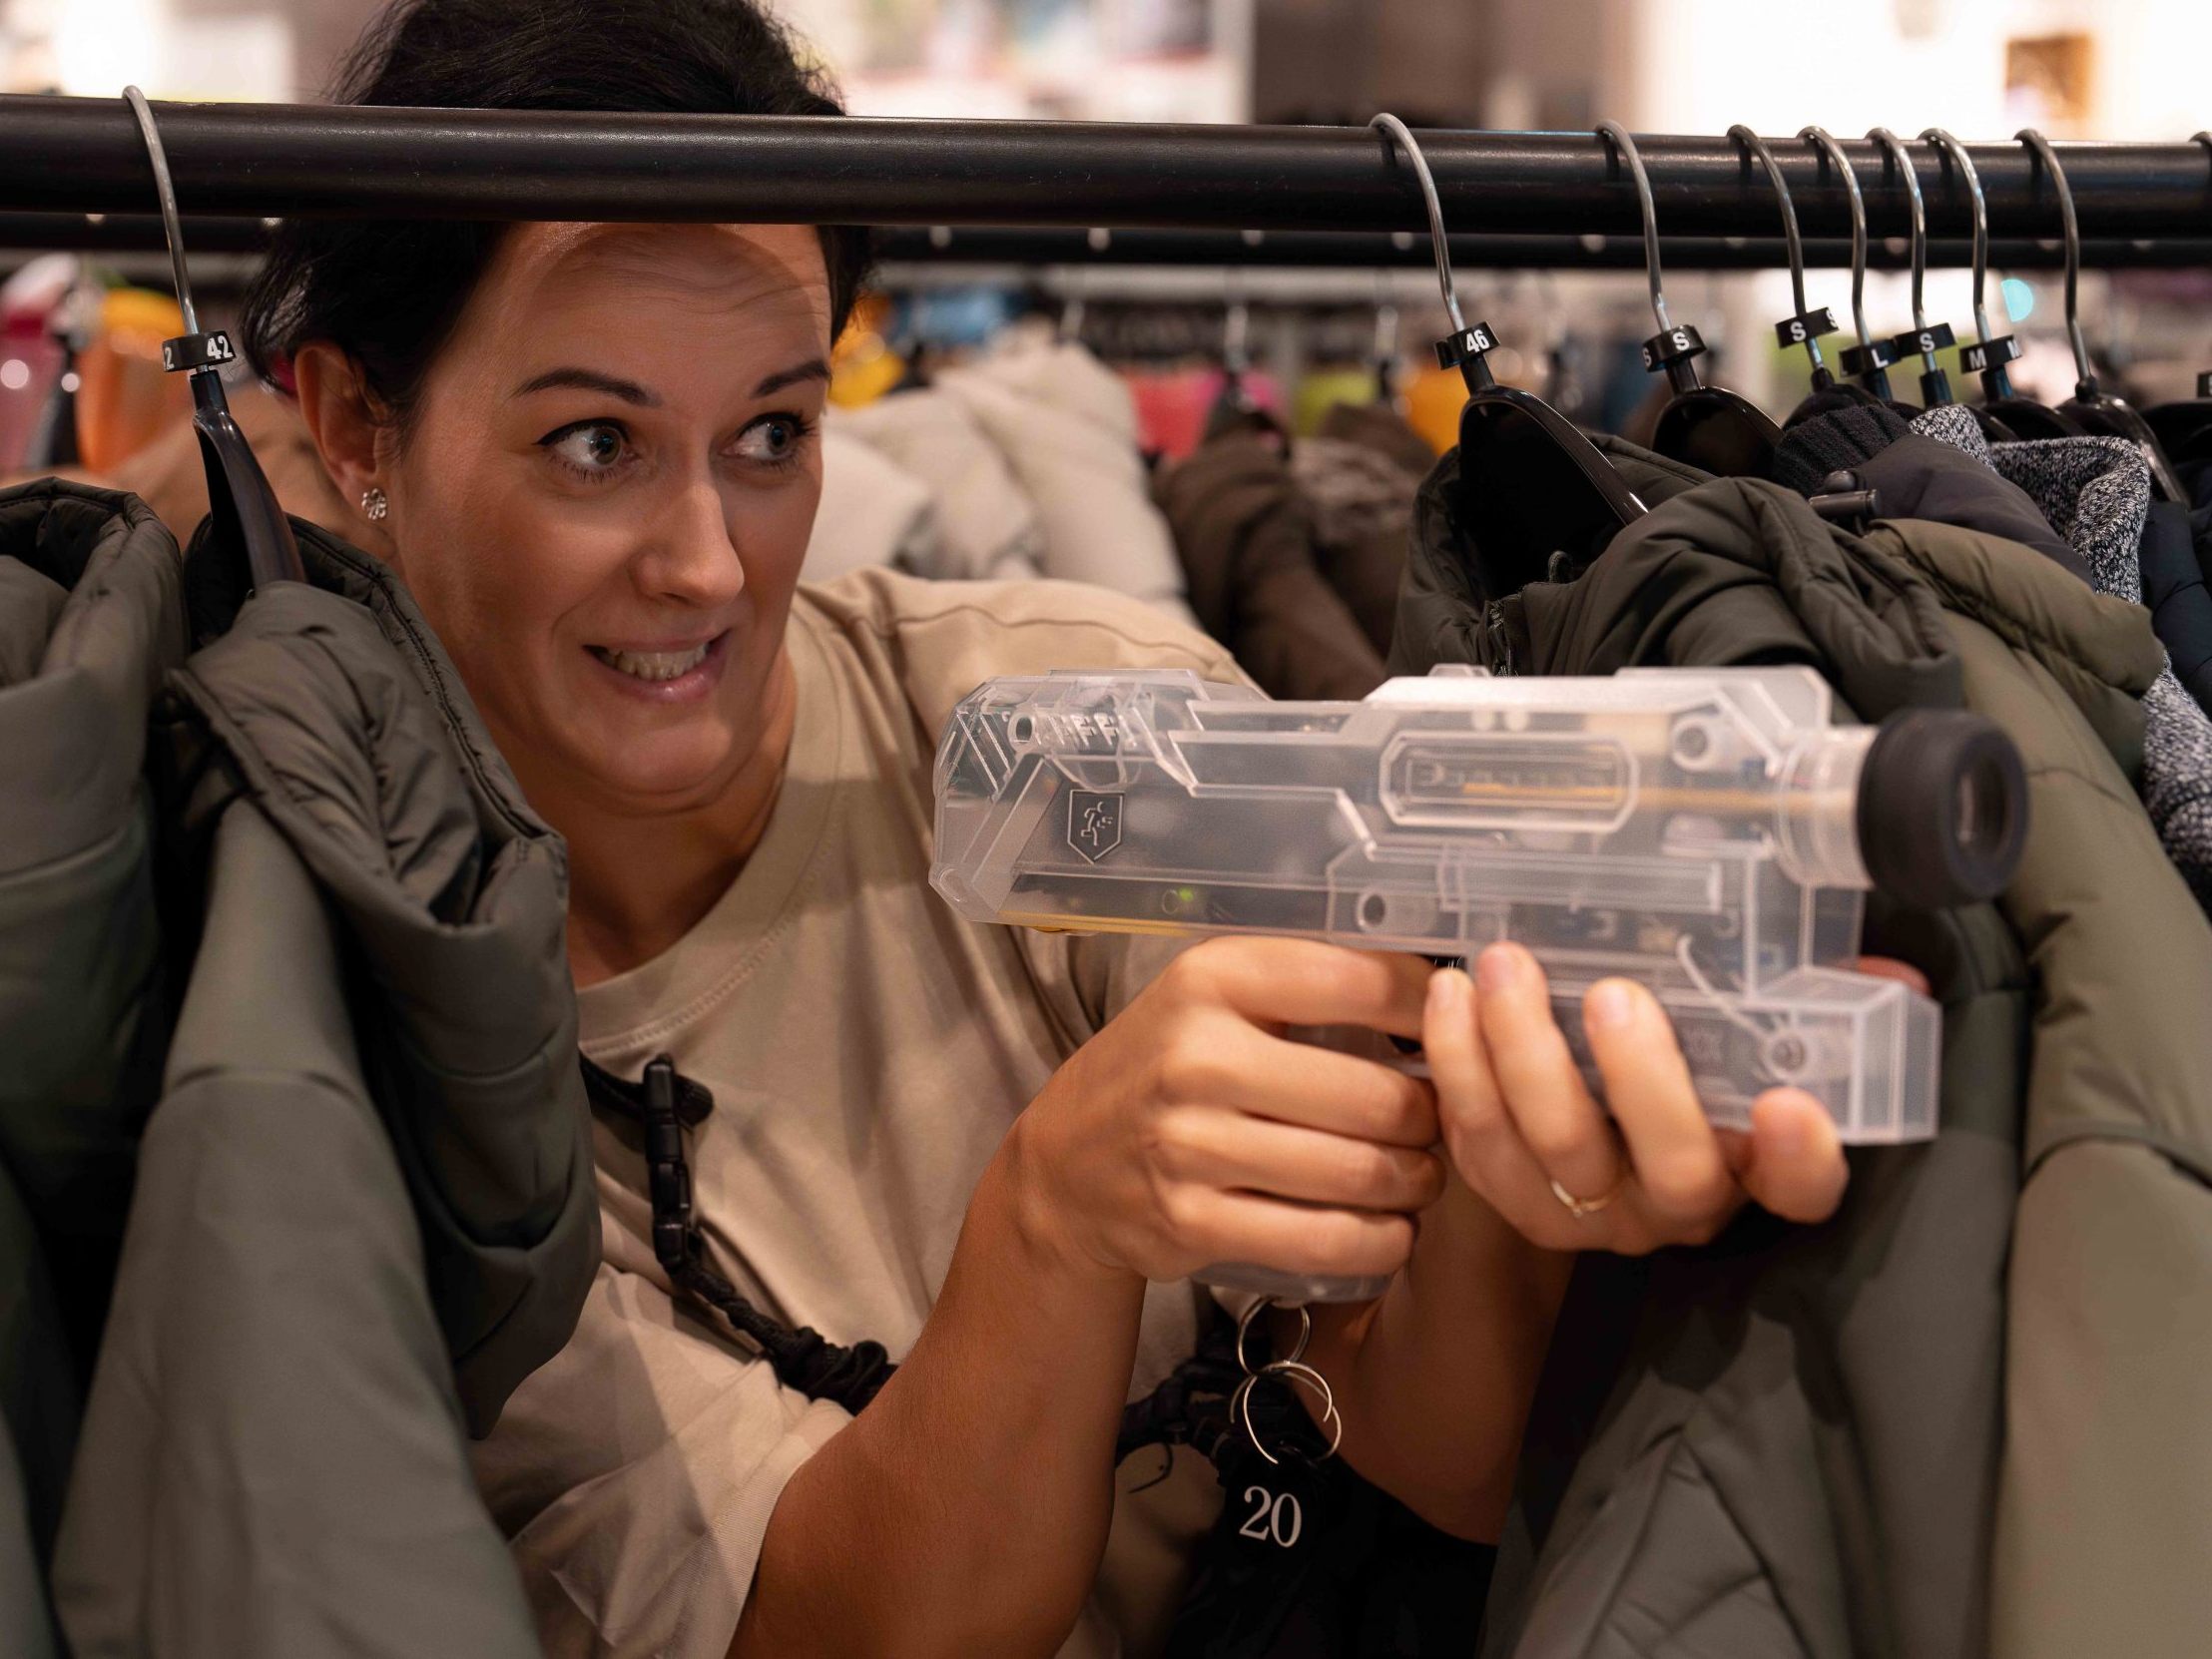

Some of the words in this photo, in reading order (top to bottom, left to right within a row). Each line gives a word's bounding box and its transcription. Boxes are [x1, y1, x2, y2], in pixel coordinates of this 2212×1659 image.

[1465, 328, 1490, 352] 46
[1672, 331, 1690, 351] S
[1790, 320, 1807, 341] S
[1920, 332, 1936, 352] S
[164, 346, 175, 370] 2
[207, 335, 234, 359] 42
[1871, 348, 1889, 368] L
[1968, 346, 1987, 370] M
[1239, 1485, 1302, 1548] 20
